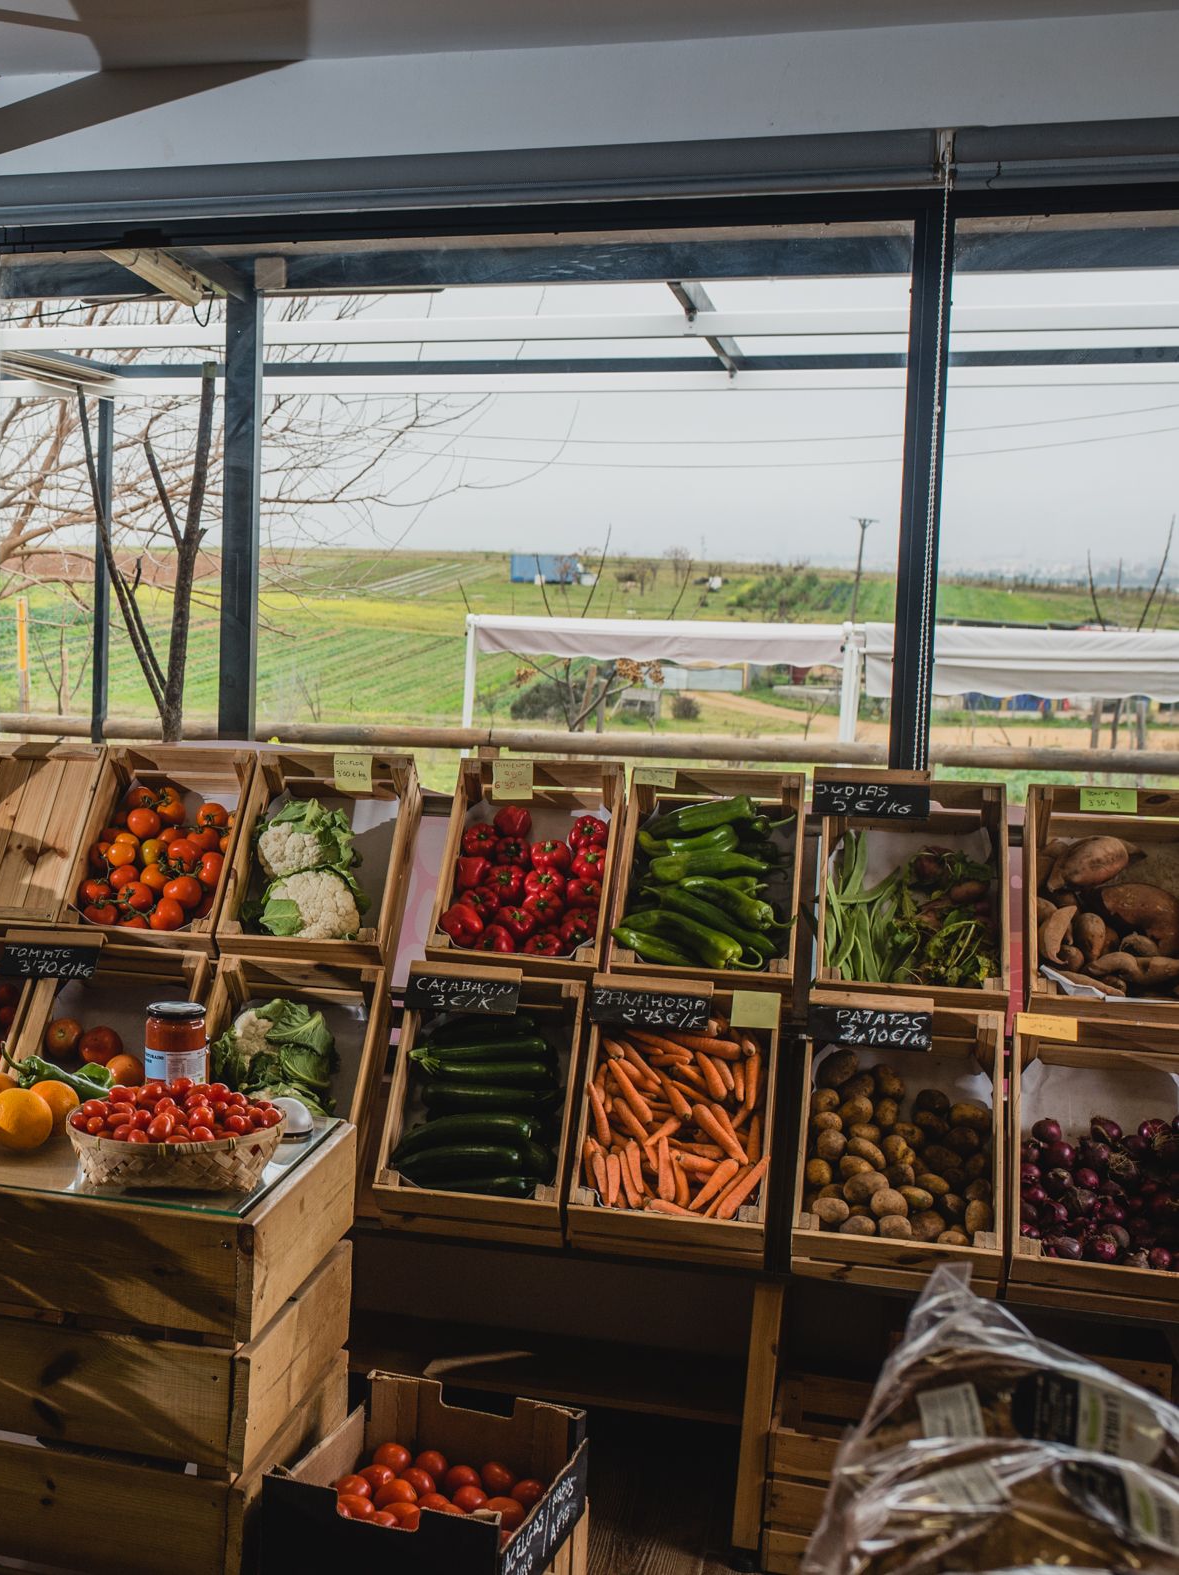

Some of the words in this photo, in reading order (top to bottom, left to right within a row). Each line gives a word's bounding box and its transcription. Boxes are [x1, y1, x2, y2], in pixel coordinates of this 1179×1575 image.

[815, 784, 889, 797] JUDIAS
[5, 946, 74, 959] TOMATE
[594, 989, 706, 1011] ZANAHORIA
[836, 1009, 927, 1031] PATATAS
